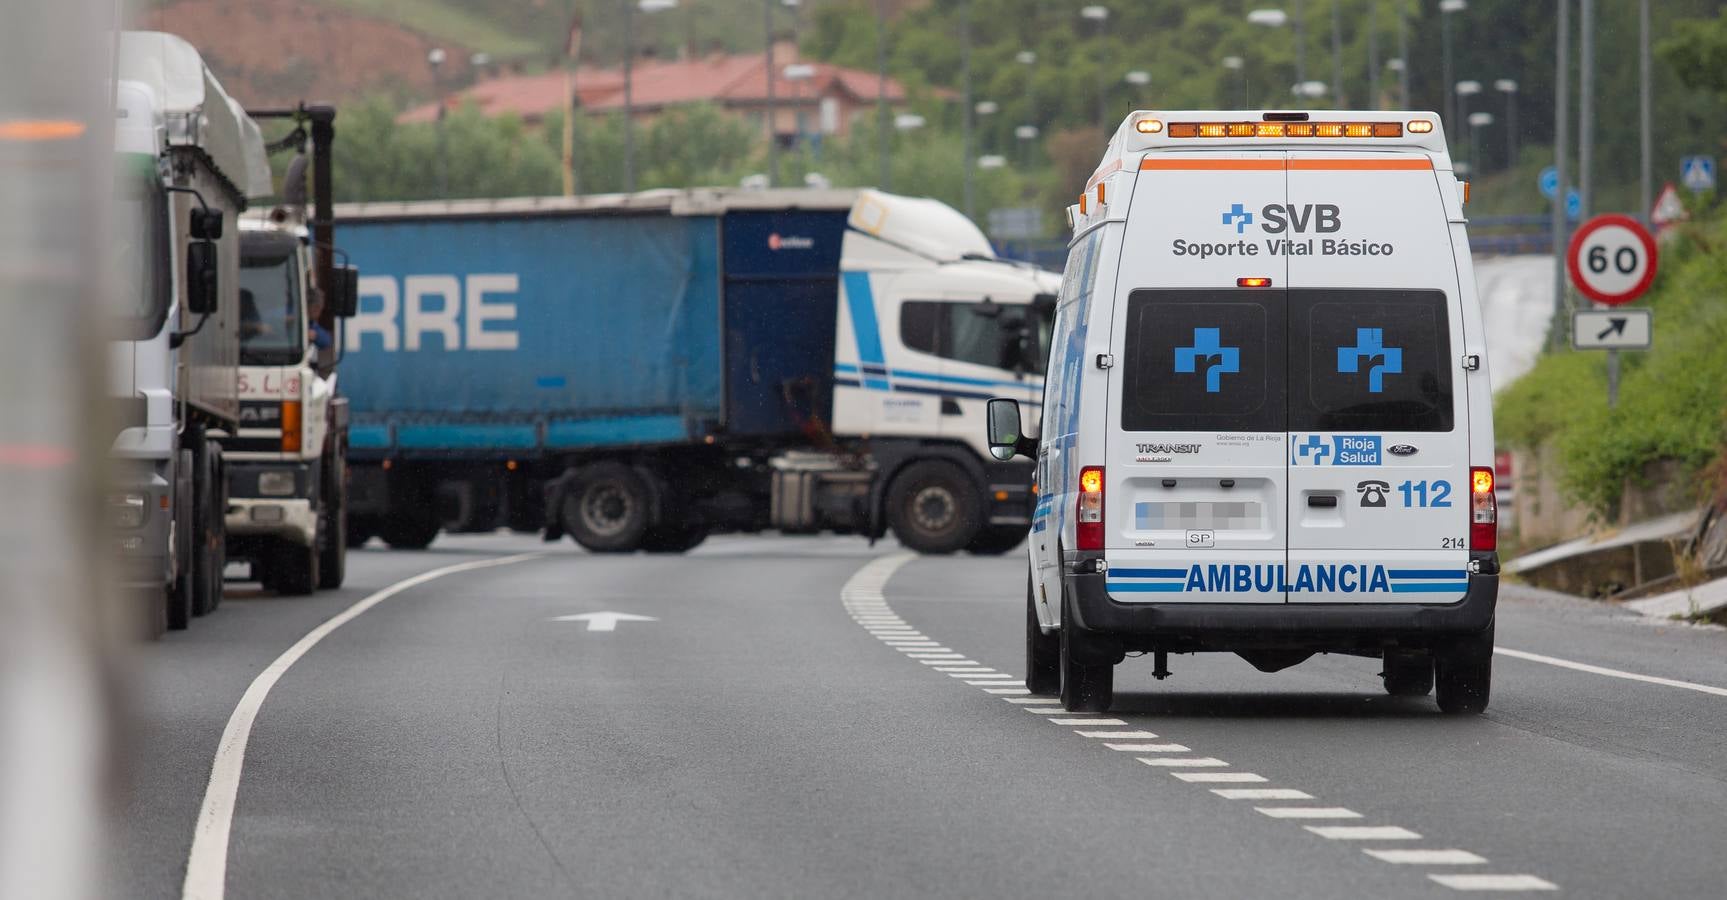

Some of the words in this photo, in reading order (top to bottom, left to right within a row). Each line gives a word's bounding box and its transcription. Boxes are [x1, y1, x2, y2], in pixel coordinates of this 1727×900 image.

[1261, 204, 1341, 234] SVB
[1172, 239, 1259, 259] Soporte
[1266, 239, 1313, 256] Vital
[1322, 239, 1394, 256] Básico
[1587, 246, 1638, 275] 60
[1135, 443, 1202, 454] TRANSIT
[1342, 438, 1375, 451] Rioja
[1340, 452, 1377, 463] Salud
[1398, 480, 1452, 507] 112
[1190, 533, 1210, 544] SP
[1441, 537, 1465, 549] 214
[1186, 564, 1389, 593] AMBULANCIA
